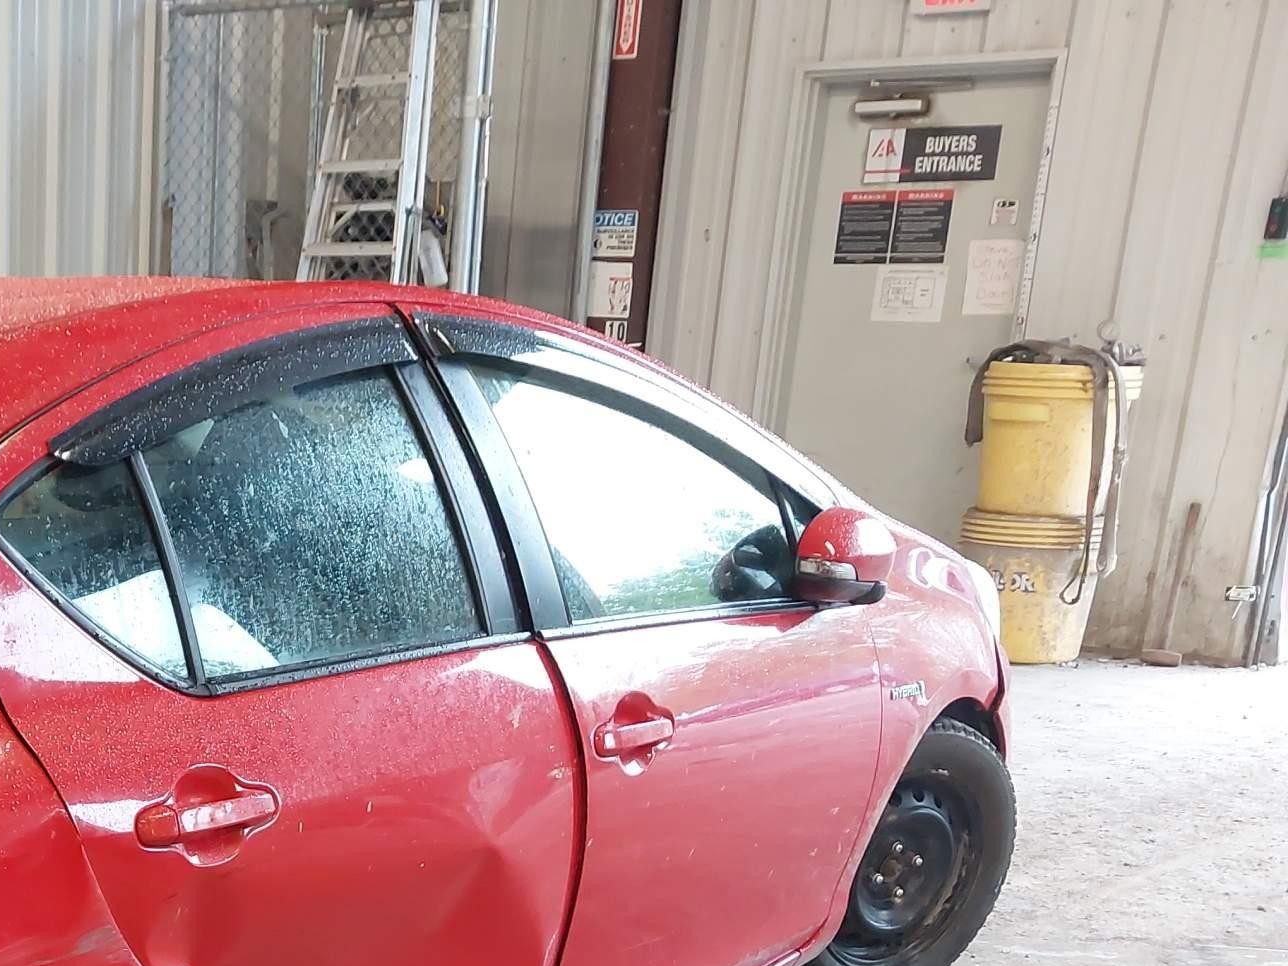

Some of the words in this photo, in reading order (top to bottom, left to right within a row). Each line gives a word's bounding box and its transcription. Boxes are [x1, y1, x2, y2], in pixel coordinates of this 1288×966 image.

[925, 134, 977, 154] BUYERS
[914, 154, 983, 174] ENTRANCE
[594, 213, 634, 226] OTICE
[608, 322, 625, 341] 10
